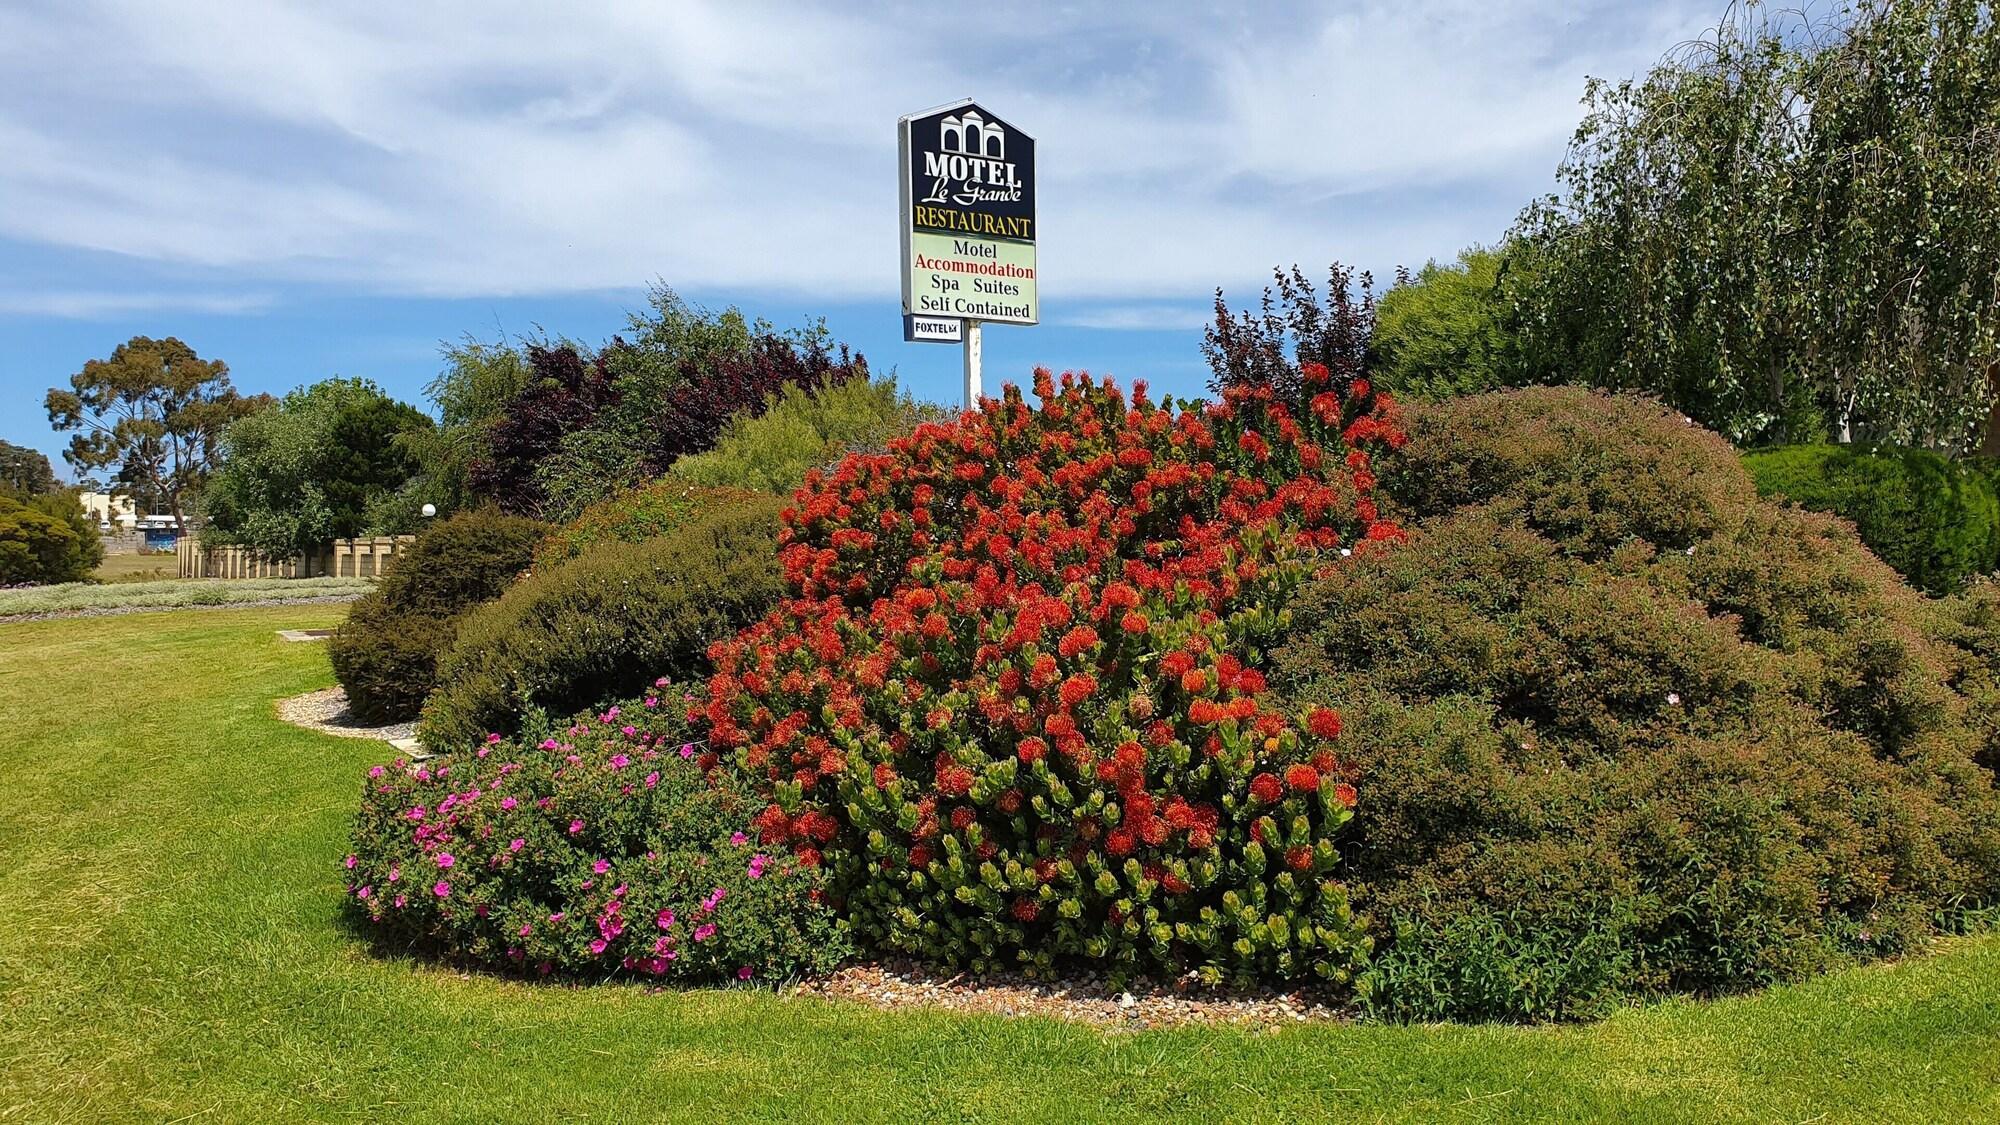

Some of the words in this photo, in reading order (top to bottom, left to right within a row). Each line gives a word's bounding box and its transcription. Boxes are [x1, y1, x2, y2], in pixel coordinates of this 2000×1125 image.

[924, 151, 1022, 188] MOTEL
[921, 175, 949, 204] Le
[952, 176, 1022, 206] Grande
[915, 205, 1031, 237] RESTAURANT
[953, 240, 997, 259] Motel
[914, 253, 1034, 279] Accommodation
[931, 274, 960, 293] Spa
[973, 278, 1019, 296] Suites
[920, 295, 950, 312] Self
[954, 298, 1030, 318] Contained
[915, 322, 948, 334] FOXTEL
